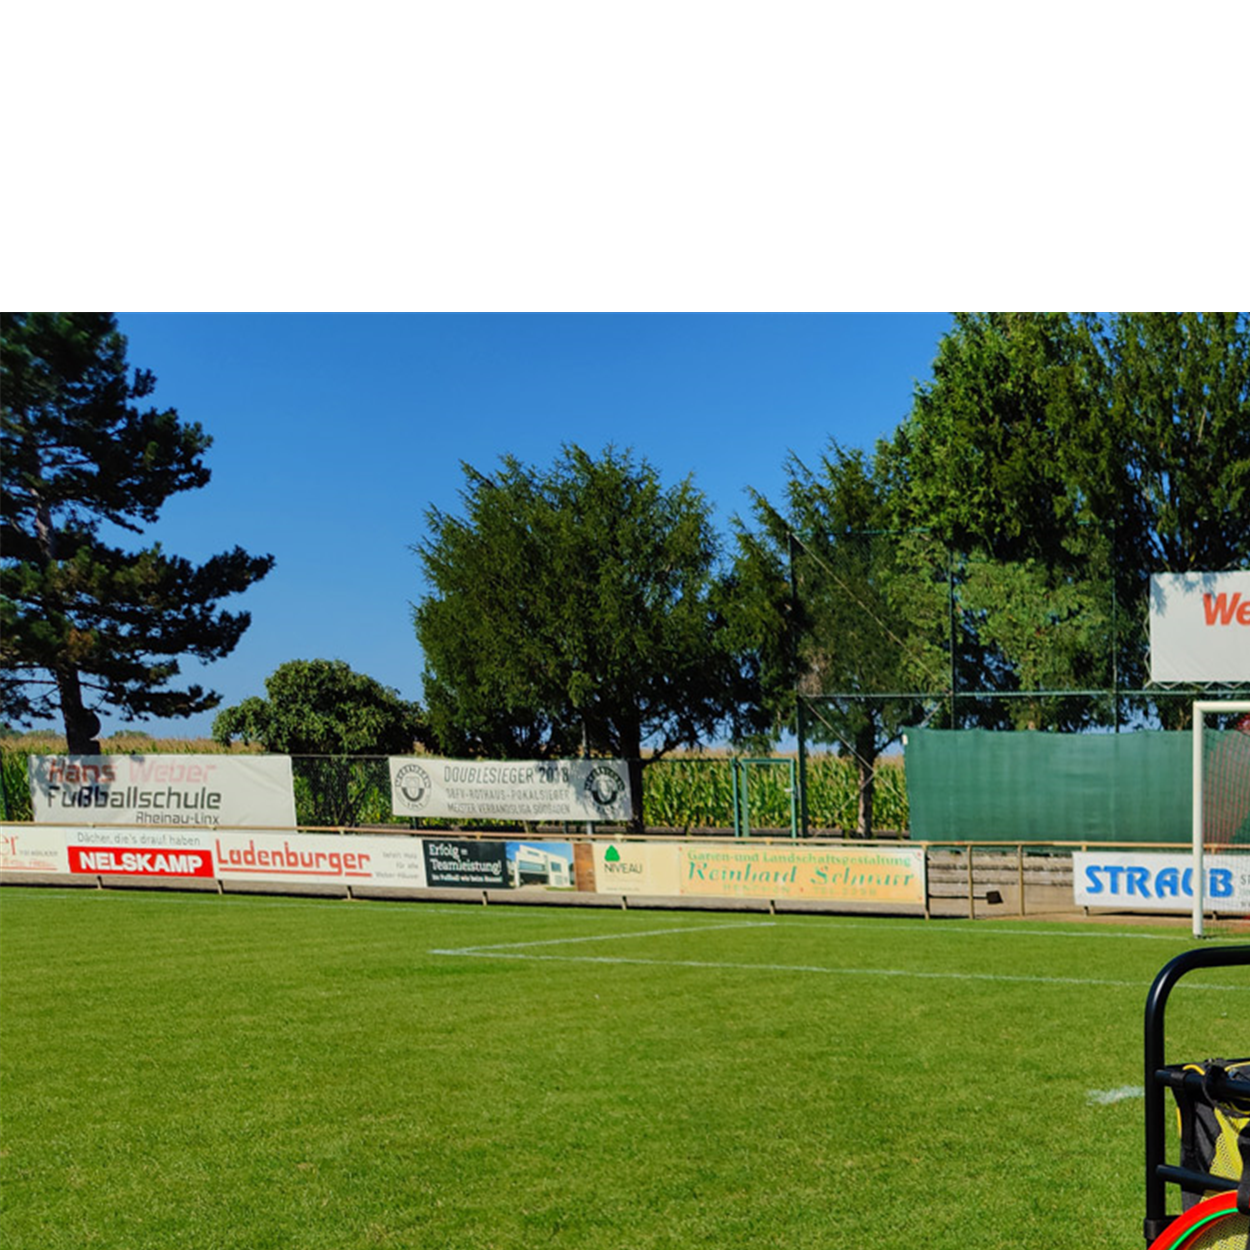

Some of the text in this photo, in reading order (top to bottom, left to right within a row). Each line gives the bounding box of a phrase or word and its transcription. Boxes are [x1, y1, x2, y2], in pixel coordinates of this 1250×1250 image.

[48, 759, 217, 783] Hans Weber
[444, 765, 534, 784] DOUBLESIEGER
[538, 766, 570, 784] 2018
[47, 785, 222, 809] Fußballschule
[136, 812, 220, 825] Rheinau-Linx
[140, 833, 166, 845] drauf
[168, 835, 201, 846] haben
[215, 838, 372, 871] Ladenburger
[429, 843, 459, 861] Erfolg
[79, 851, 204, 873] NELSKAMP
[430, 858, 502, 876] Teamleistung!
[604, 862, 643, 874] NIVEAU
[689, 861, 798, 883] Reinhard
